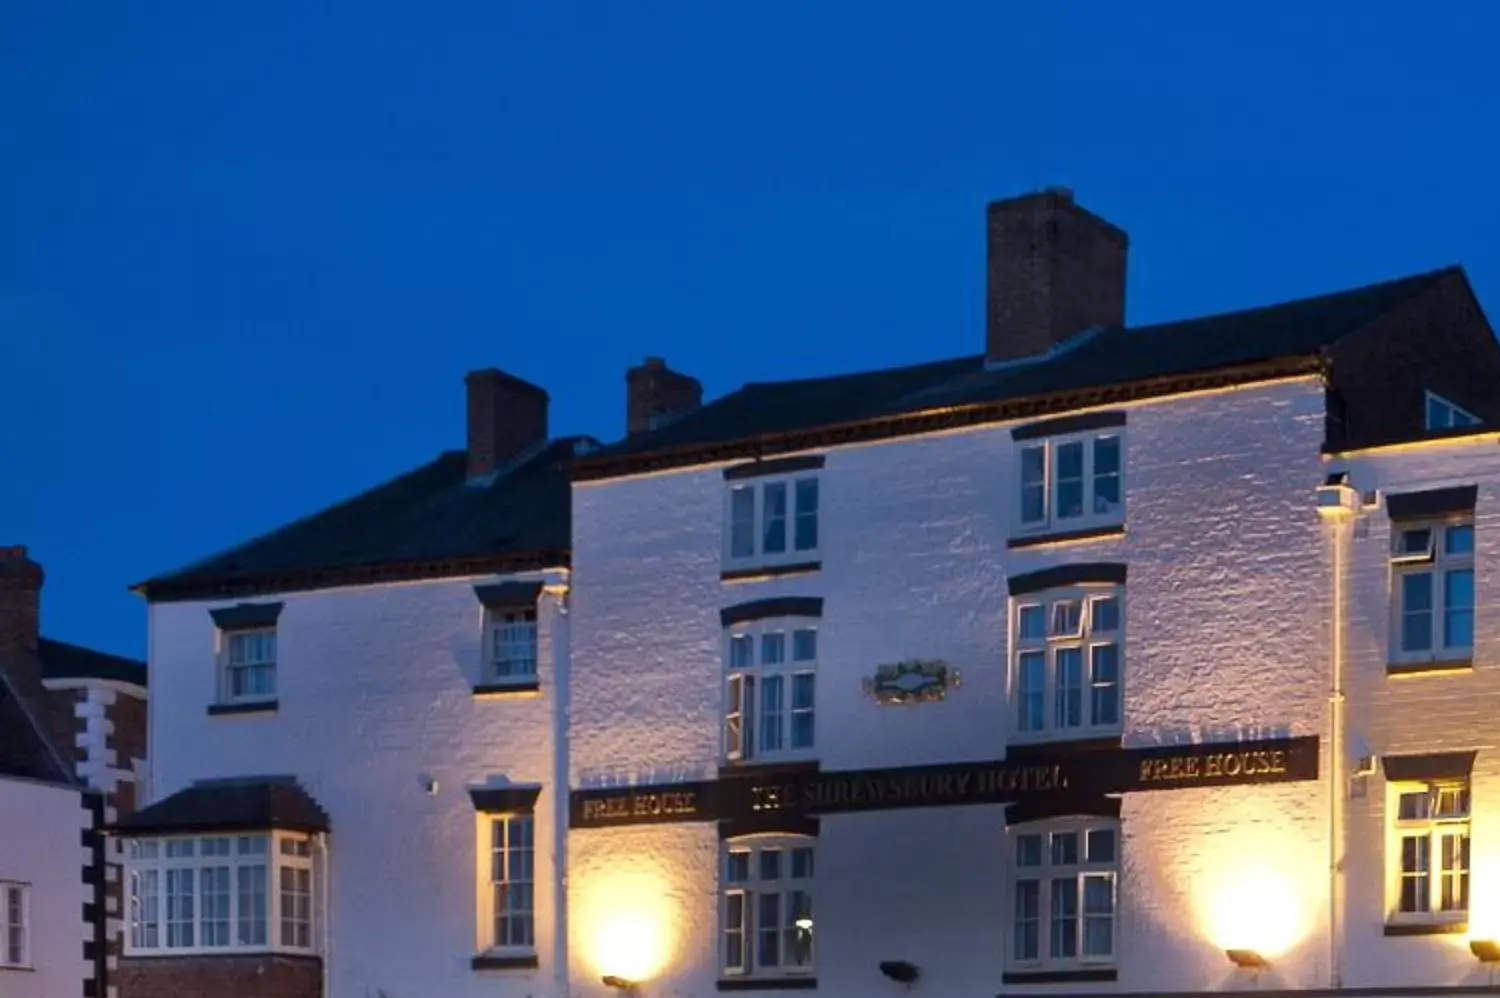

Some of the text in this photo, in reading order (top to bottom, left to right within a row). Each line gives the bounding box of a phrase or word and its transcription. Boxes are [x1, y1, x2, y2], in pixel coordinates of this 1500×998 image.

[1139, 750, 1285, 781] FREE HOUSE
[803, 771, 971, 801] SHREWSBURY
[976, 766, 1068, 794] HOTEL
[583, 792, 697, 820] FREE HOUSE
